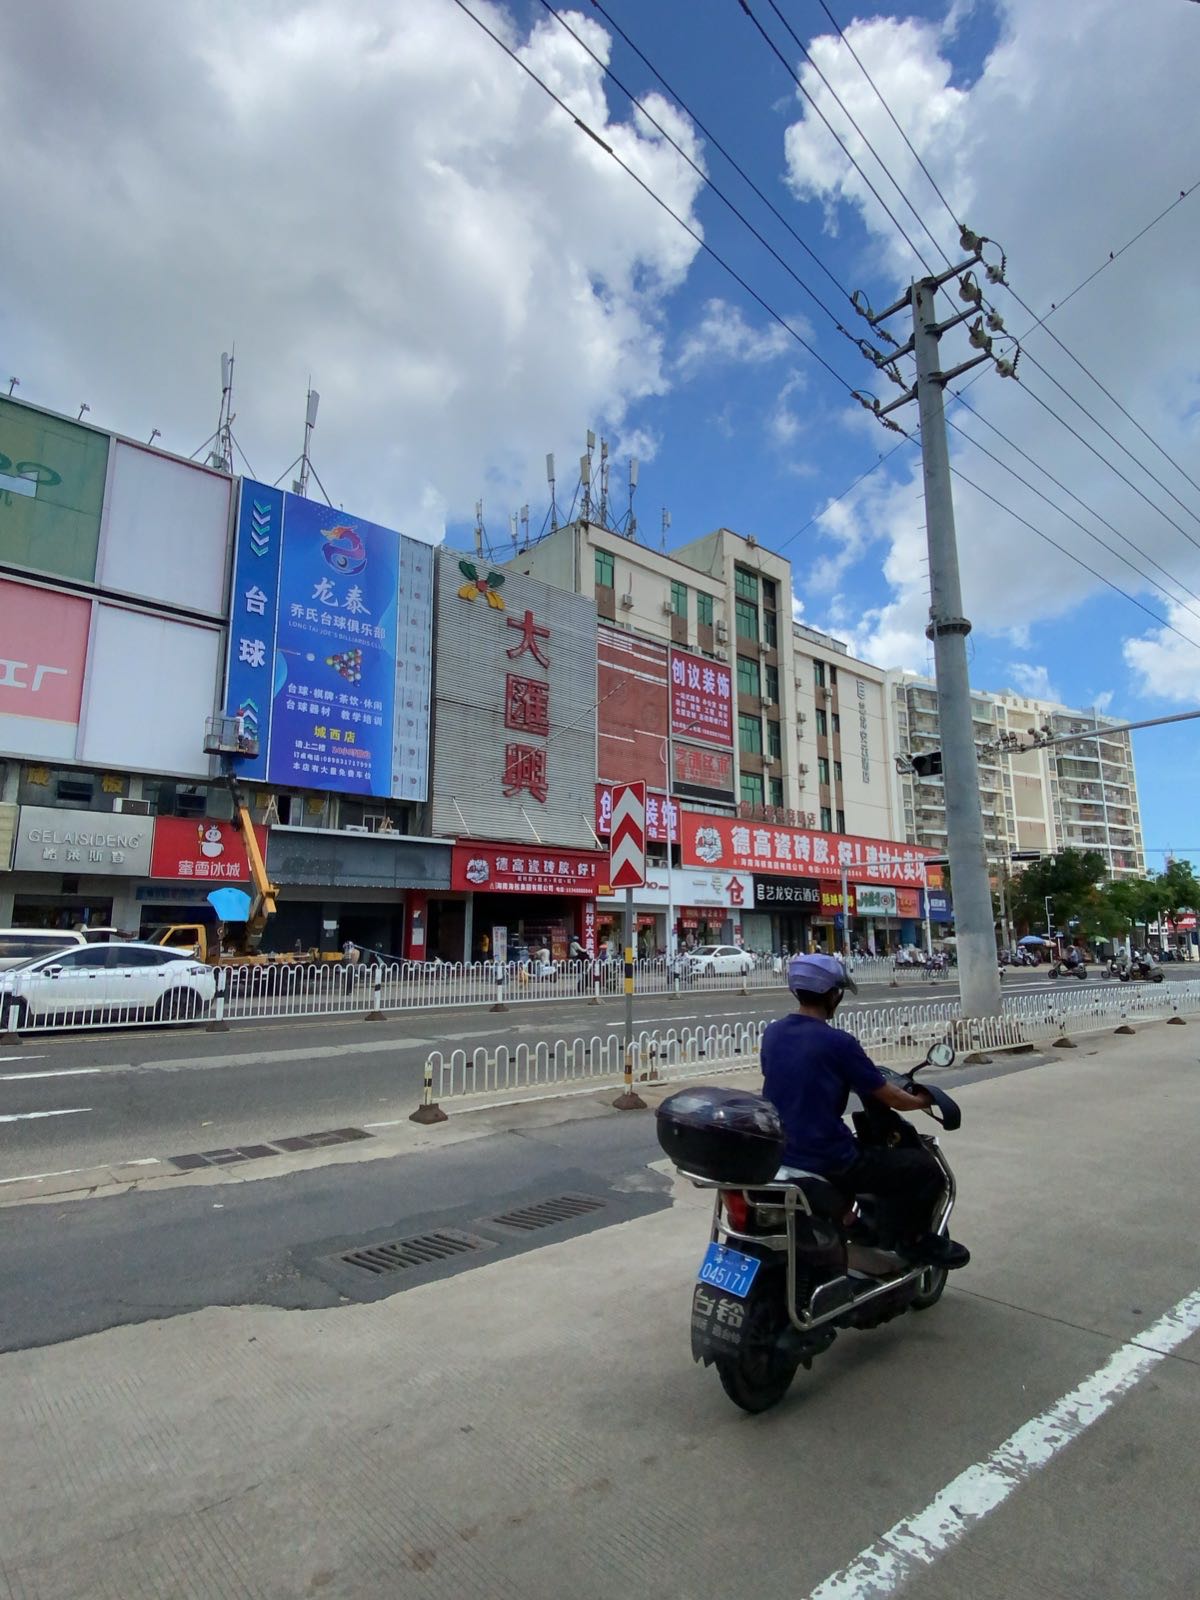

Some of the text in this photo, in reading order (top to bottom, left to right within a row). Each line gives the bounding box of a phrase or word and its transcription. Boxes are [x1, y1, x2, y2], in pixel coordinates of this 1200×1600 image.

[312, 577, 372, 615] 龙泰
[239, 585, 268, 668] 台球
[288, 620, 307, 630] LONG
[290, 603, 386, 640] 乔氏台球俱乐部
[671, 657, 730, 700] 创议装饰
[286, 699, 332, 718] 台球器材
[502, 609, 550, 804] 大匯興
[313, 725, 356, 743] 城西店
[292, 761, 372, 780] 本店有大量免费车位
[28, 828, 140, 849] GELAISIDENG
[178, 860, 241, 878] 蜜雪冰城
[495, 856, 596, 877] 德高瓷砖胶,好!
[766, 884, 821, 903] 艺龙安云酒店
[702, 1262, 746, 1292] 045171
